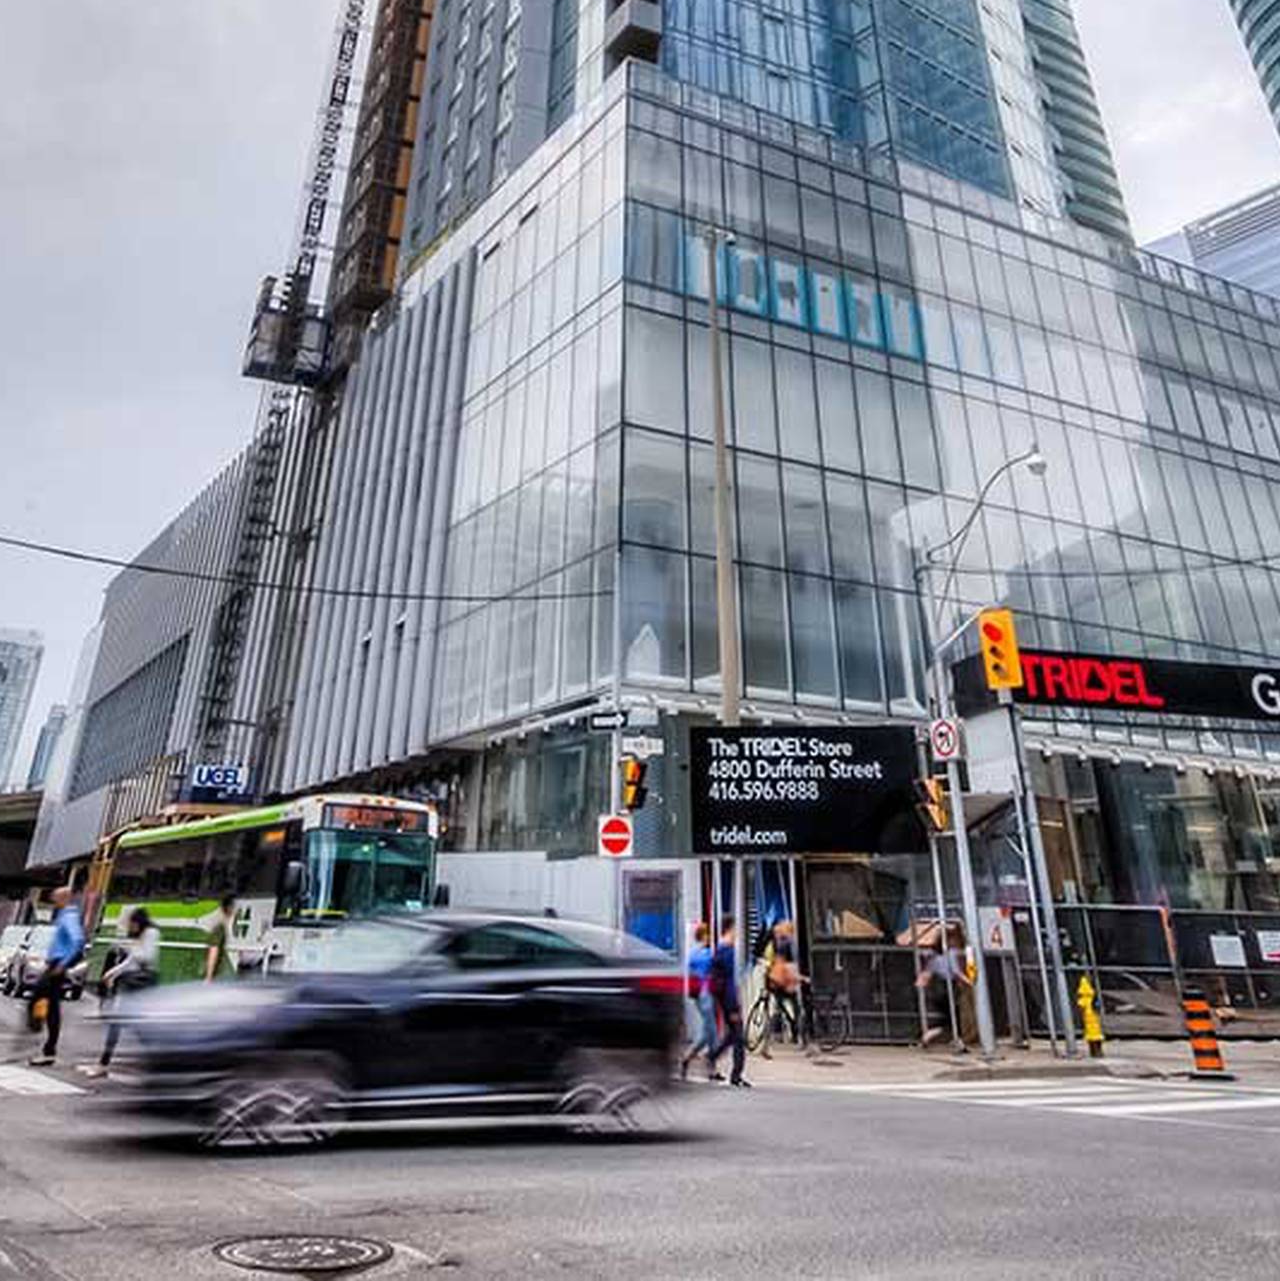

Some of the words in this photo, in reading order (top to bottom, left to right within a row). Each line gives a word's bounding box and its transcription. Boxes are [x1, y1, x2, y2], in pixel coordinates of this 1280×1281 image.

[1019, 654, 1165, 708] TRIDEL
[707, 737, 738, 757] The
[809, 738, 852, 757] Store
[708, 759, 751, 779] 4800
[755, 758, 825, 779] Dufferin
[829, 759, 883, 779] Street
[708, 781, 820, 801] 416.596.9888
[710, 825, 787, 845] tridel.com
